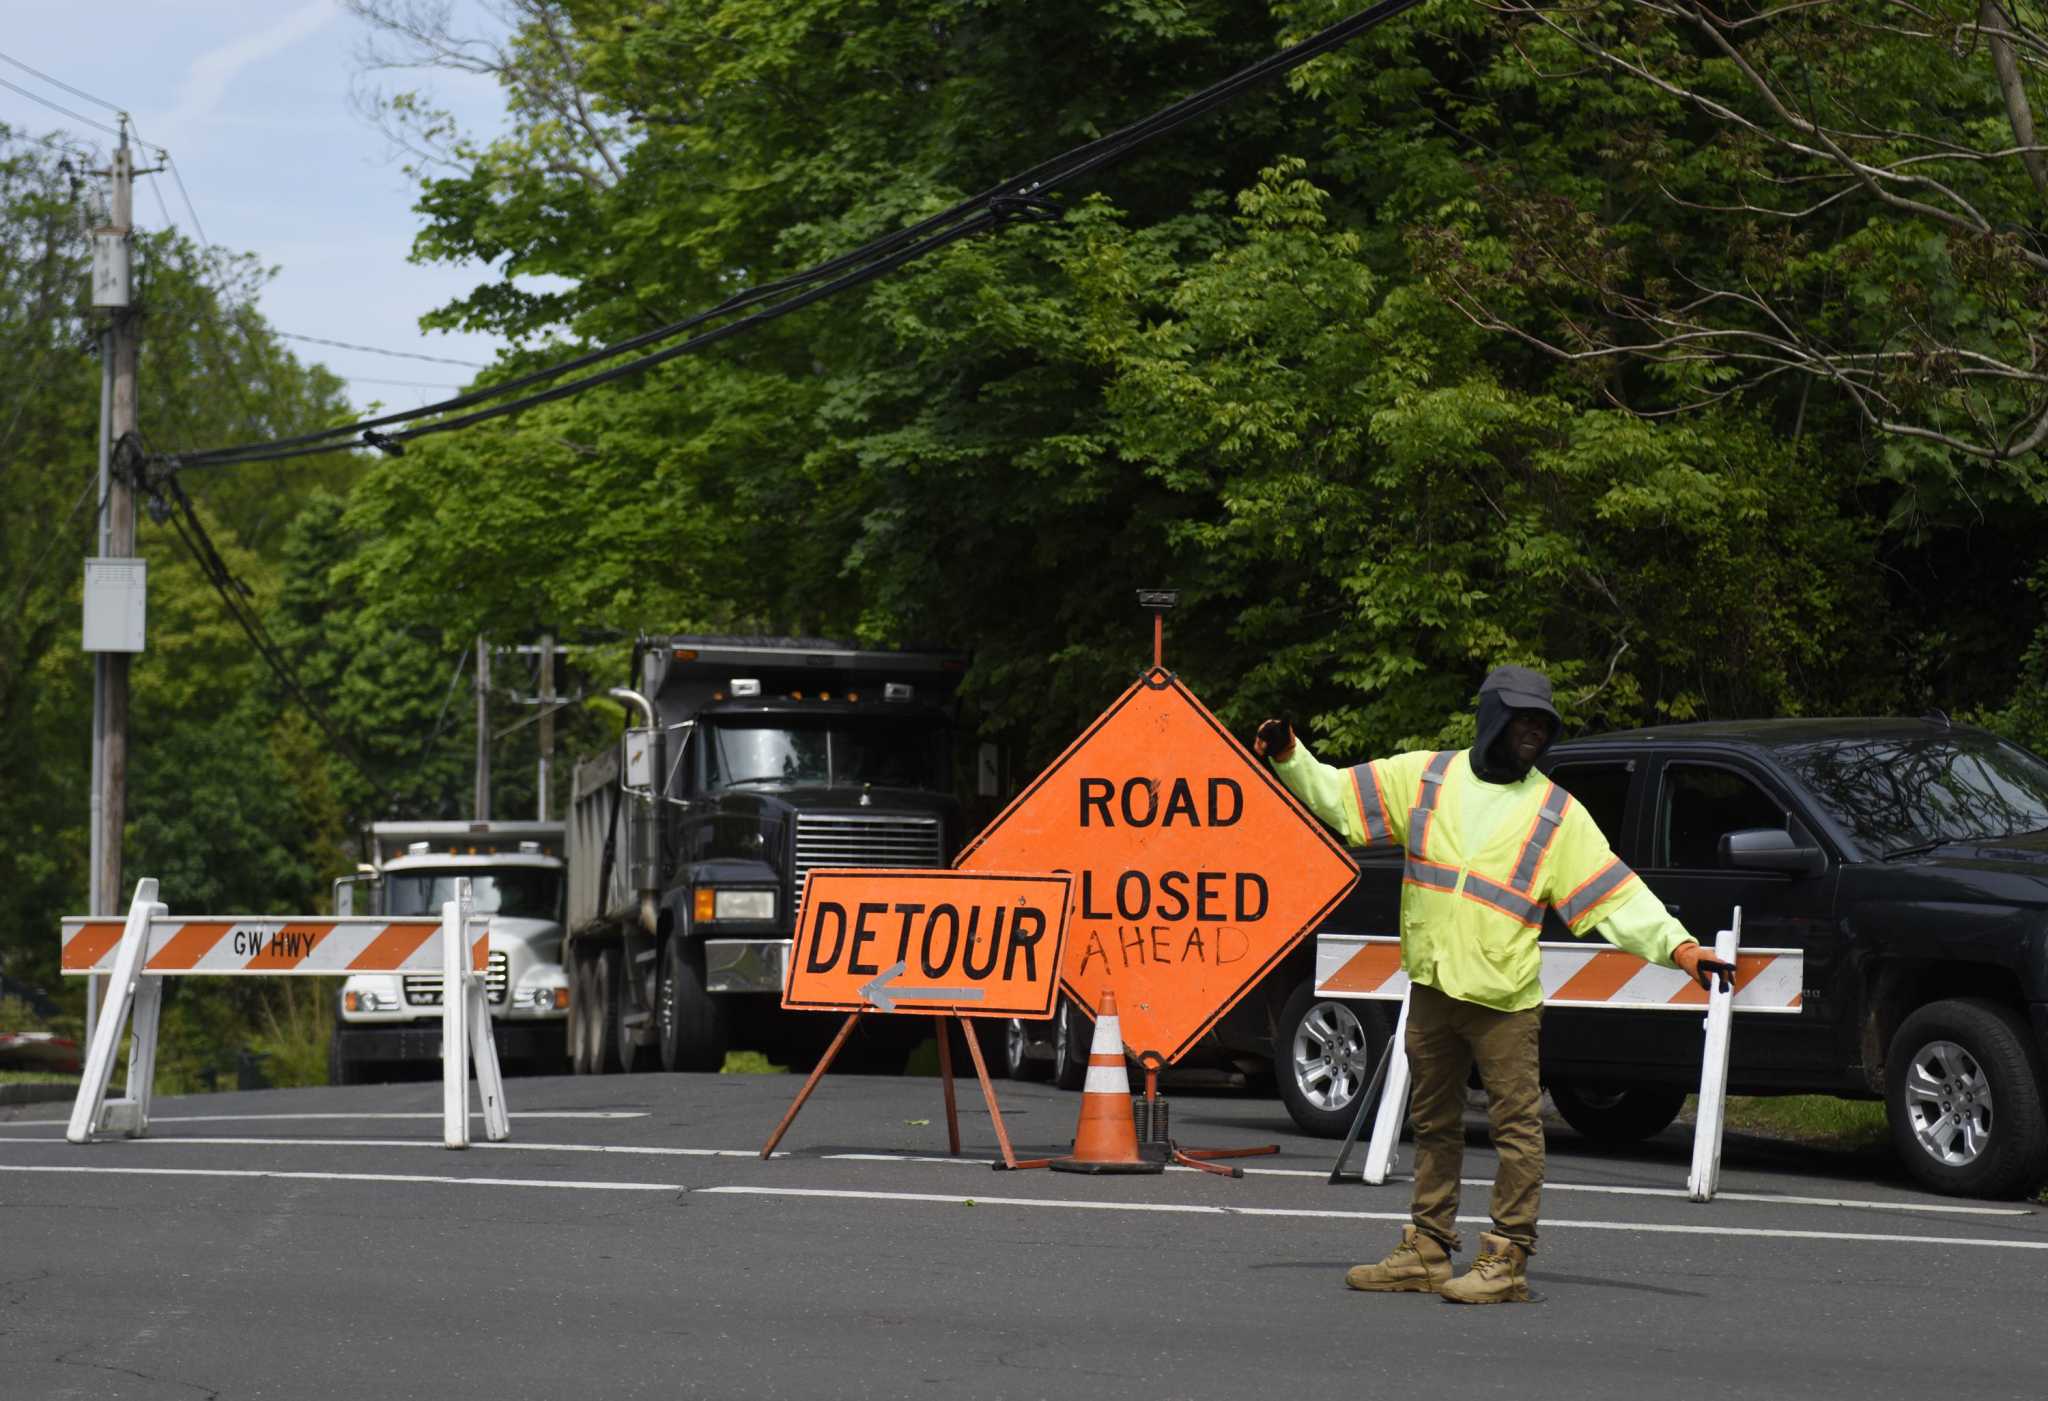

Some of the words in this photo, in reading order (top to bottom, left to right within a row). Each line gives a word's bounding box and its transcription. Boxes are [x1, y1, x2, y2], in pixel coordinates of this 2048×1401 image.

[1079, 776, 1244, 828] ROAD
[1051, 869, 1269, 922] LOSED
[234, 931, 263, 956] GW
[271, 932, 315, 958] HWY
[806, 901, 1047, 982] DETOUR
[1080, 926, 1250, 976] AHEAD
